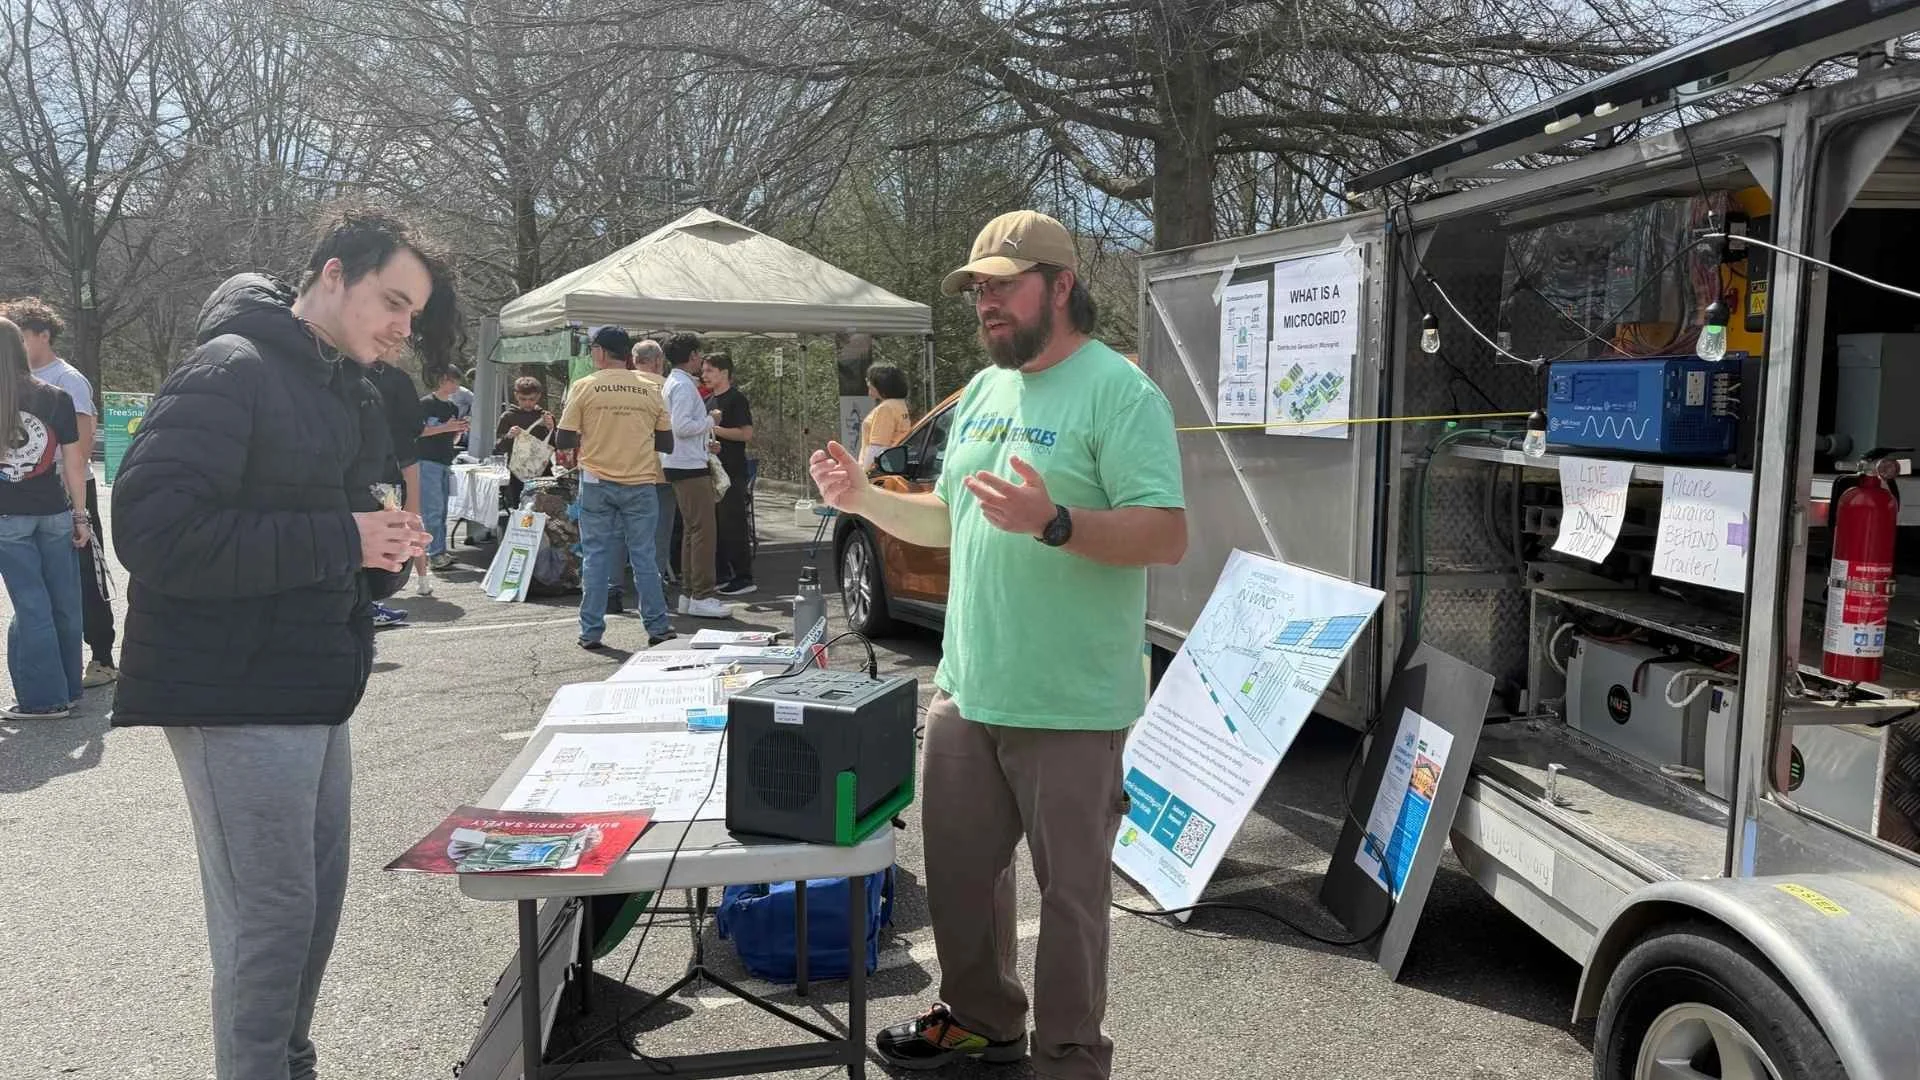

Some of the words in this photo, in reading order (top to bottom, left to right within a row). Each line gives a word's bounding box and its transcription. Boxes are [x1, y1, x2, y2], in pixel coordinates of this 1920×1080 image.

[1290, 288, 1318, 303] WHAT
[1321, 286, 1330, 300] IS
[1332, 284, 1340, 298] A
[1284, 310, 1346, 328] MICROGRID?
[594, 384, 648, 396] VOLUNTEER
[1671, 471, 1717, 498] Phone
[1664, 525, 1720, 551] BEHIND
[1663, 549, 1720, 582] Trailer!
[471, 819, 522, 828] SAFELY
[527, 821, 577, 829] DEBRIS
[580, 821, 621, 829] BURN
